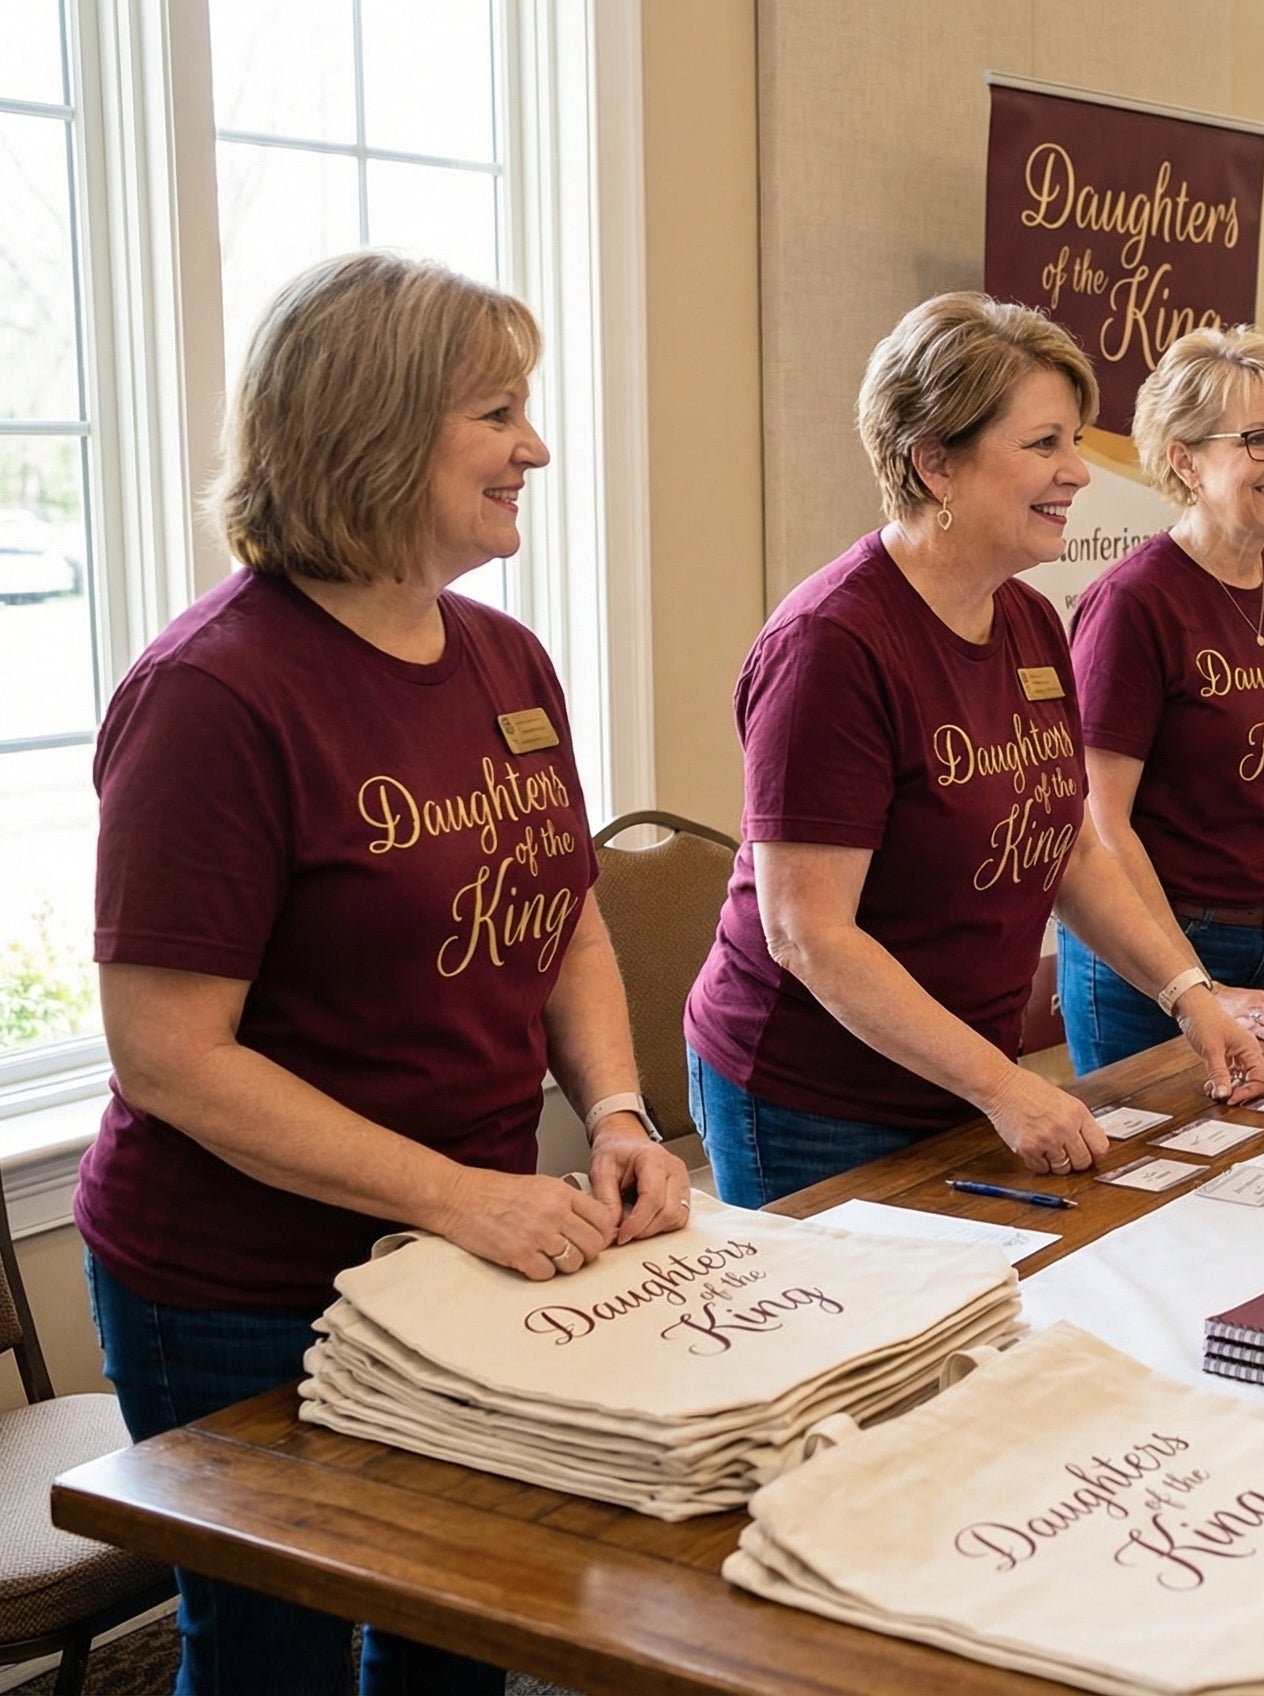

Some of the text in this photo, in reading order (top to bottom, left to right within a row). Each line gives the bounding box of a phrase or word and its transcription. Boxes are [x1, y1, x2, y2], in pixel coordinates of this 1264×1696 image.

[1021, 142, 1239, 270] Daughters
[1042, 245, 1108, 310] of the
[933, 713, 1075, 794] Daughters
[1034, 767, 1077, 814] of the
[358, 757, 570, 854] Daughters
[973, 798, 1078, 892] King
[515, 819, 575, 877] of the
[437, 856, 579, 978] King
[524, 1240, 758, 1346] Daughters
[660, 1284, 845, 1357] King
[699, 1270, 767, 1302] of the
[954, 1432, 1190, 1571] Daughters
[1144, 1468, 1211, 1512] of the
